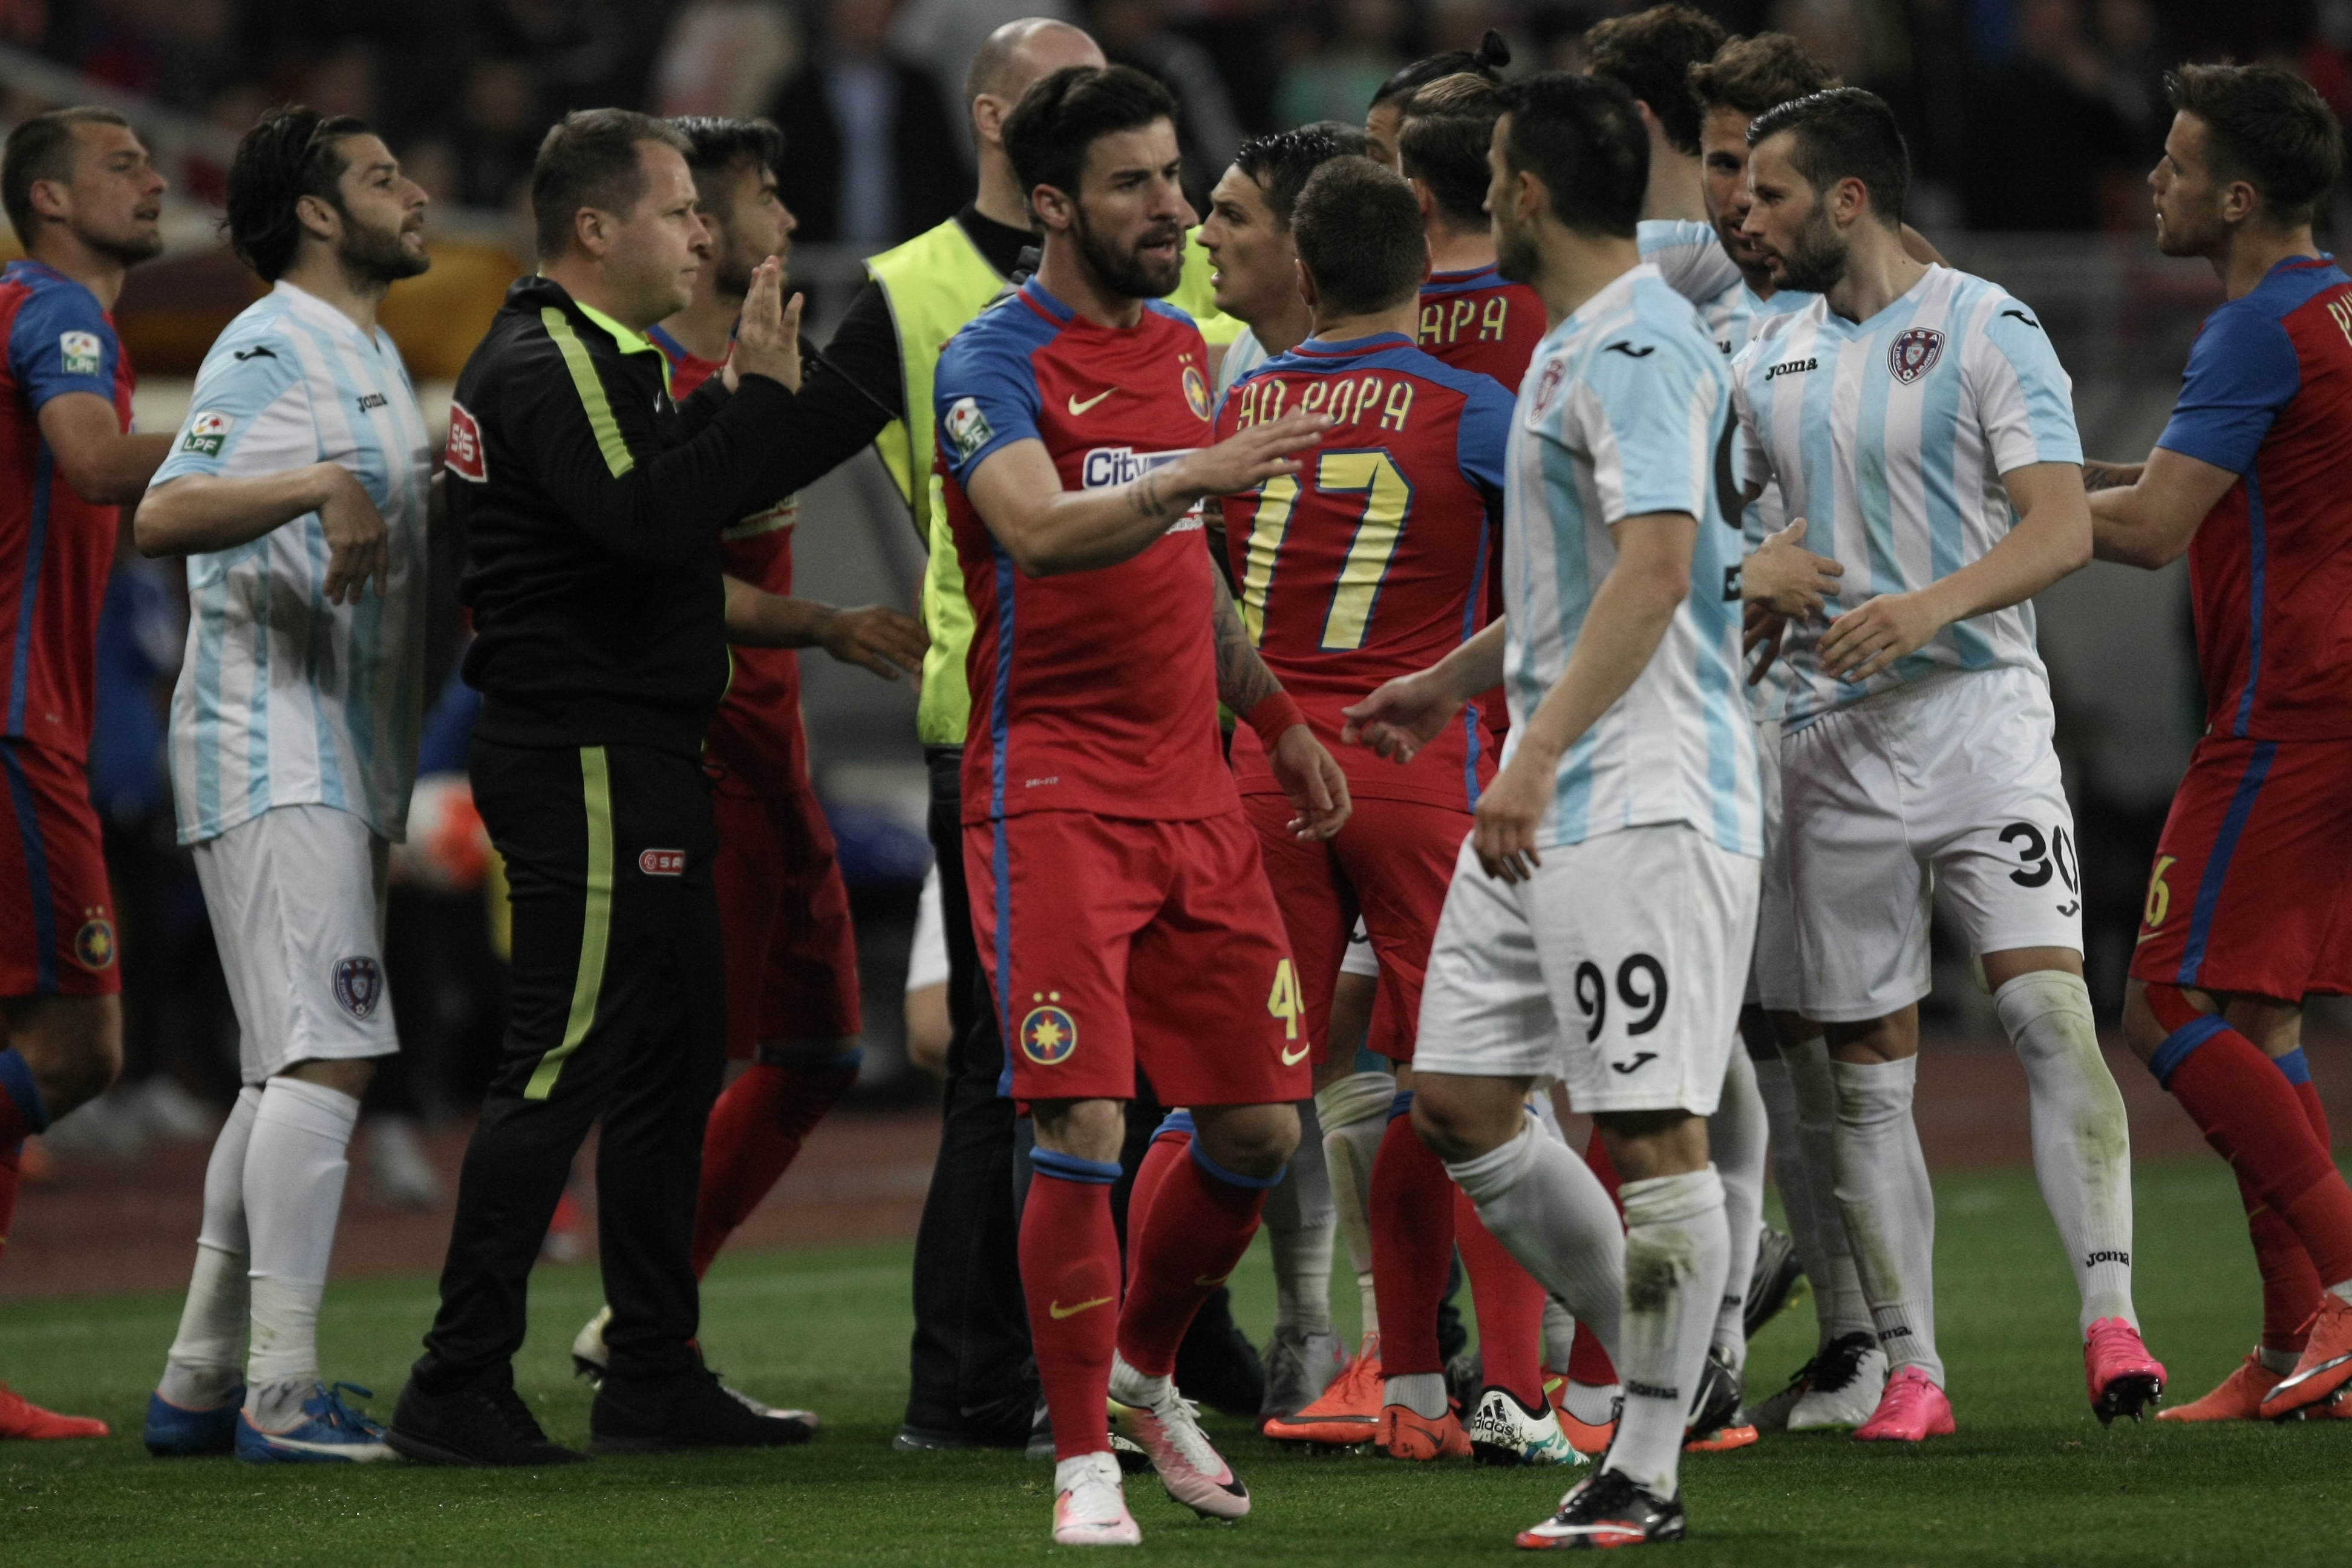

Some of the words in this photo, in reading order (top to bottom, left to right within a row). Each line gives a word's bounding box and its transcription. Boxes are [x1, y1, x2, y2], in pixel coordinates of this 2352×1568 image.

[1903, 332, 1938, 341] ASA
[1764, 357, 1818, 381] Joma
[355, 393, 388, 414] Joma
[1301, 376, 1414, 433] POPA
[183, 437, 218, 451] LPF
[1998, 822, 2079, 895] 30
[1575, 953, 1668, 1044] 99
[2085, 1250, 2130, 1269] Joma
[1472, 1417, 1515, 1436] didas
